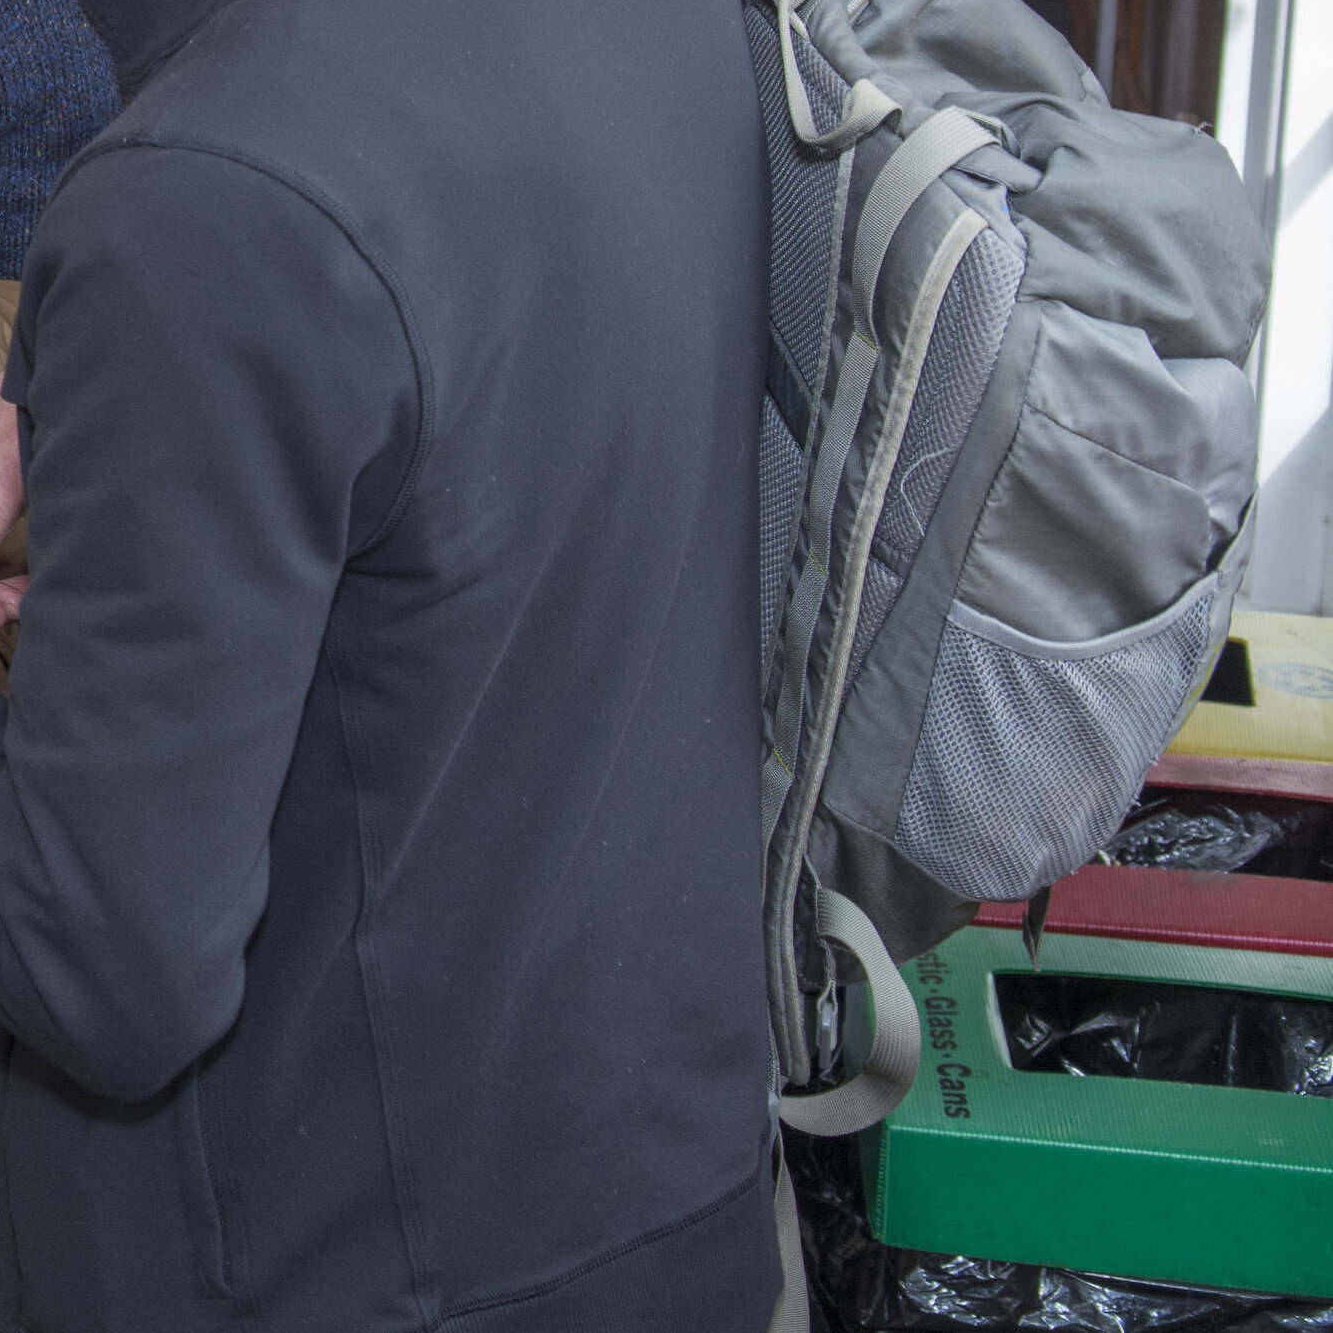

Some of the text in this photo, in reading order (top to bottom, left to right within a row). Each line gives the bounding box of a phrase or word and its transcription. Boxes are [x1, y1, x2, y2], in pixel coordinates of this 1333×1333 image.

[917, 952, 972, 1119] stic Glass Cans
